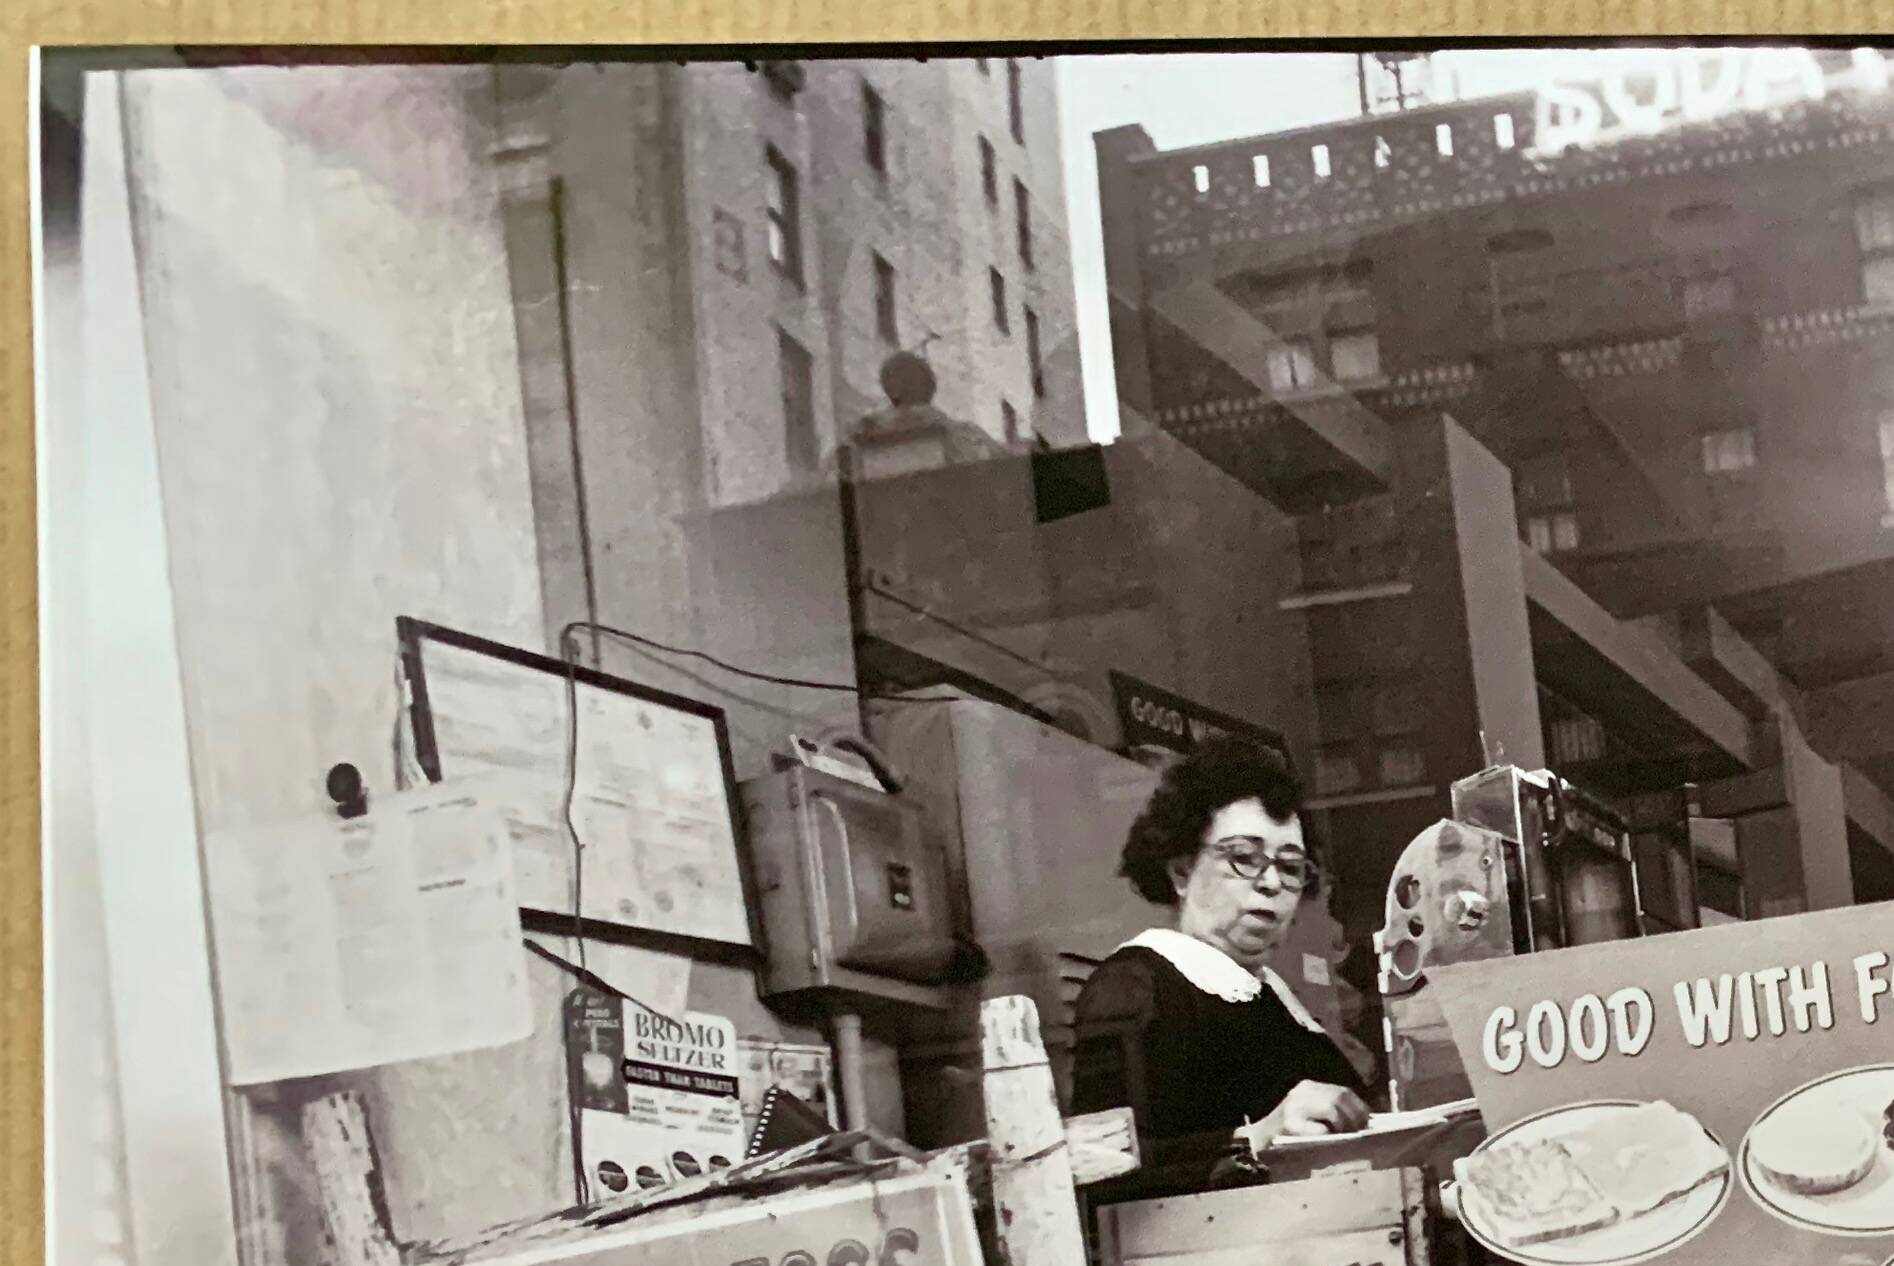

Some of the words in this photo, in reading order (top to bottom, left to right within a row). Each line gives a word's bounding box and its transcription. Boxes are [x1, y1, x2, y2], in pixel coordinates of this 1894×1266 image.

[635, 1012, 725, 1049] BROMO
[1482, 987, 1654, 1074] GOOD
[1674, 960, 1834, 1048] WITH
